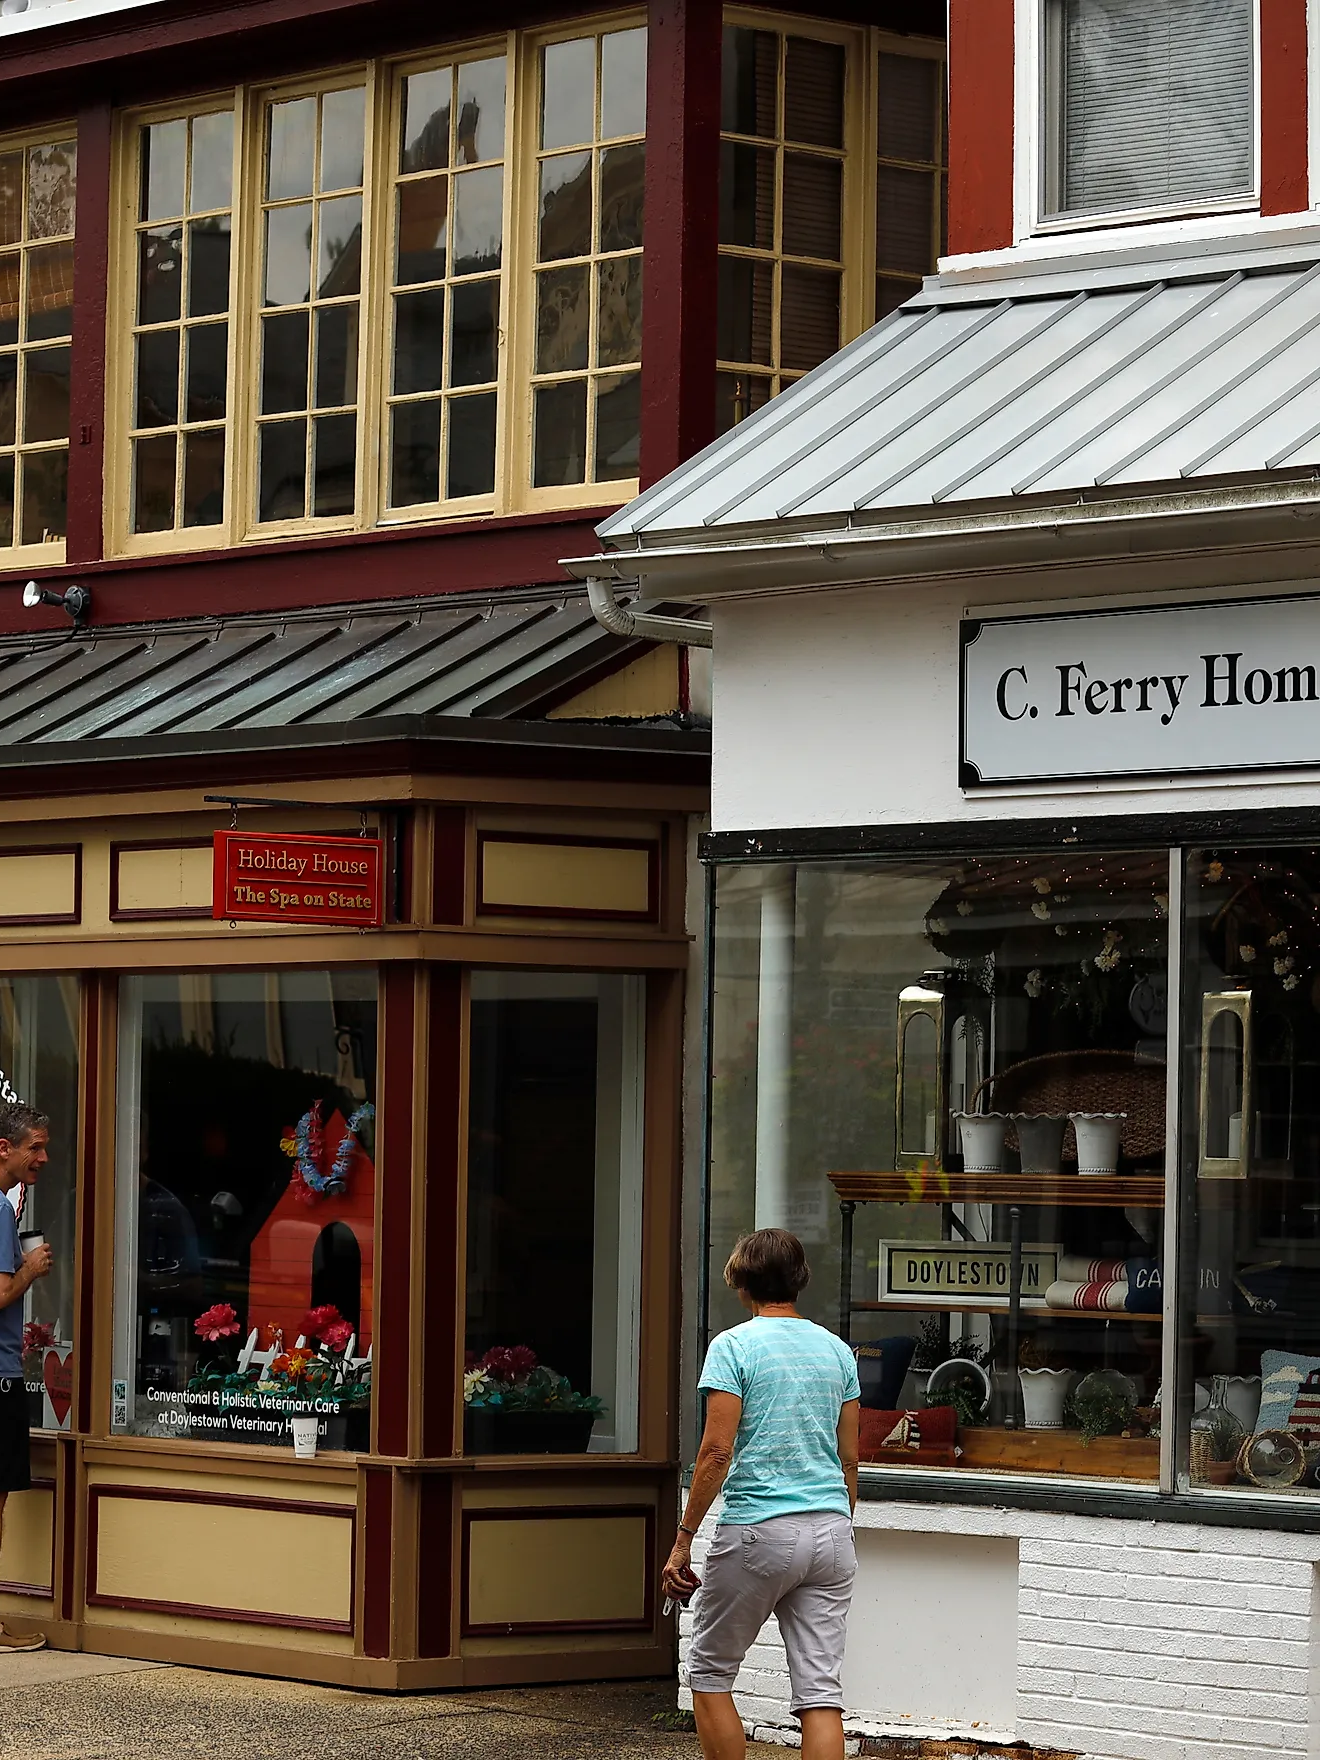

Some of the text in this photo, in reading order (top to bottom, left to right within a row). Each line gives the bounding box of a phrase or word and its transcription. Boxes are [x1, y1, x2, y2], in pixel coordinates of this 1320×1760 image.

[995, 664, 1039, 722] C.
[1054, 660, 1190, 726] Ferry
[237, 848, 369, 877] Holiday House
[233, 886, 372, 909] The Spa on State
[146, 1386, 340, 1415] Conventional & Holistic Veterinary Care
[157, 1411, 169, 1424] at
[170, 1410, 228, 1430] Doylestown
[229, 1414, 283, 1437] Veterinary
